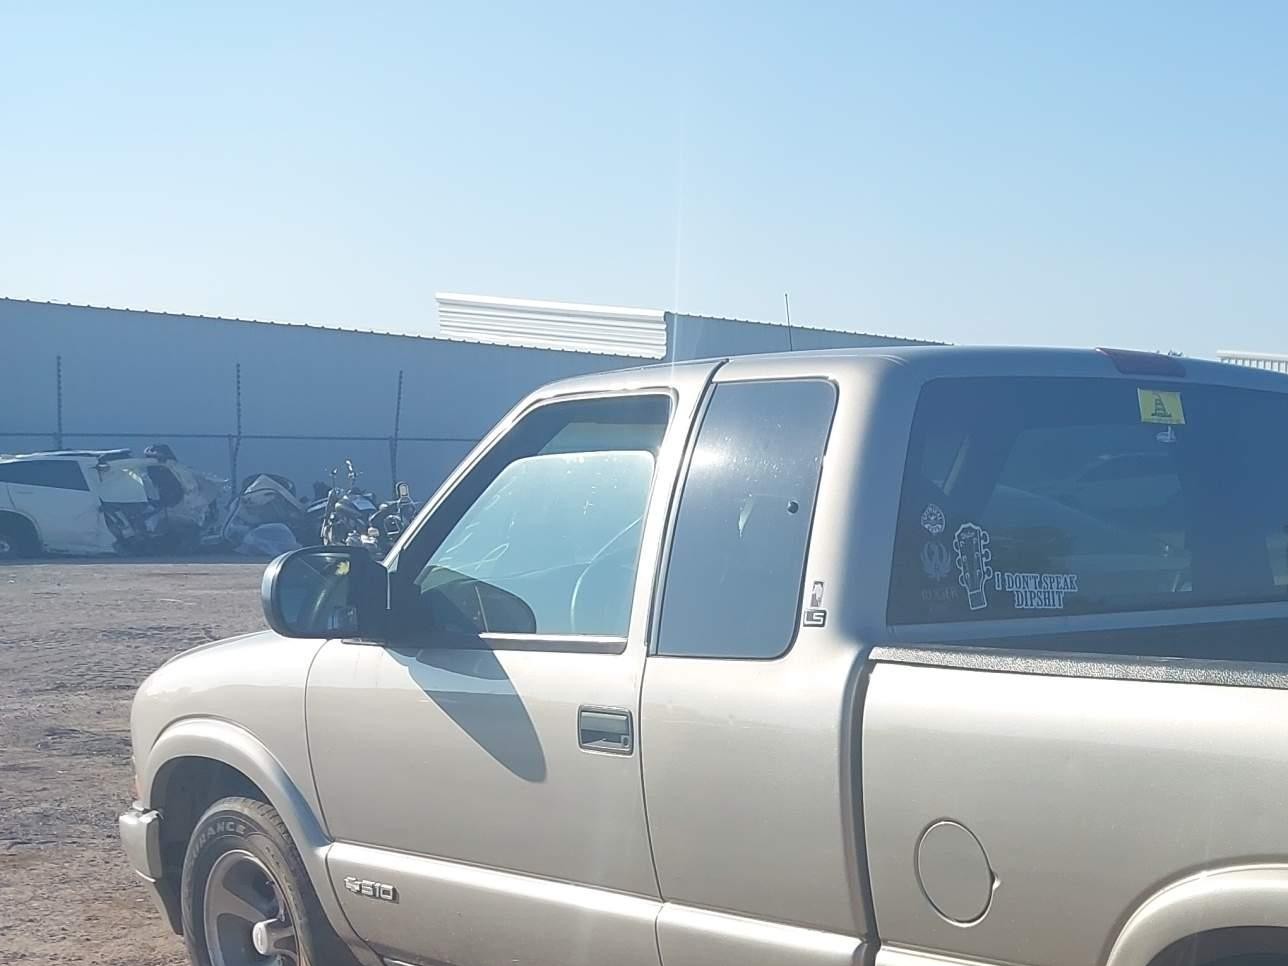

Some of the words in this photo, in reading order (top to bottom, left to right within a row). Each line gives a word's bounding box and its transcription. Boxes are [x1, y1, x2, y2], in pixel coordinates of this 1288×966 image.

[994, 572, 1002, 591] I
[1005, 572, 1040, 592] DON'T
[1041, 573, 1079, 592] SPEAK
[1014, 590, 1066, 608] DIPSHIT
[361, 879, 394, 901] S10
